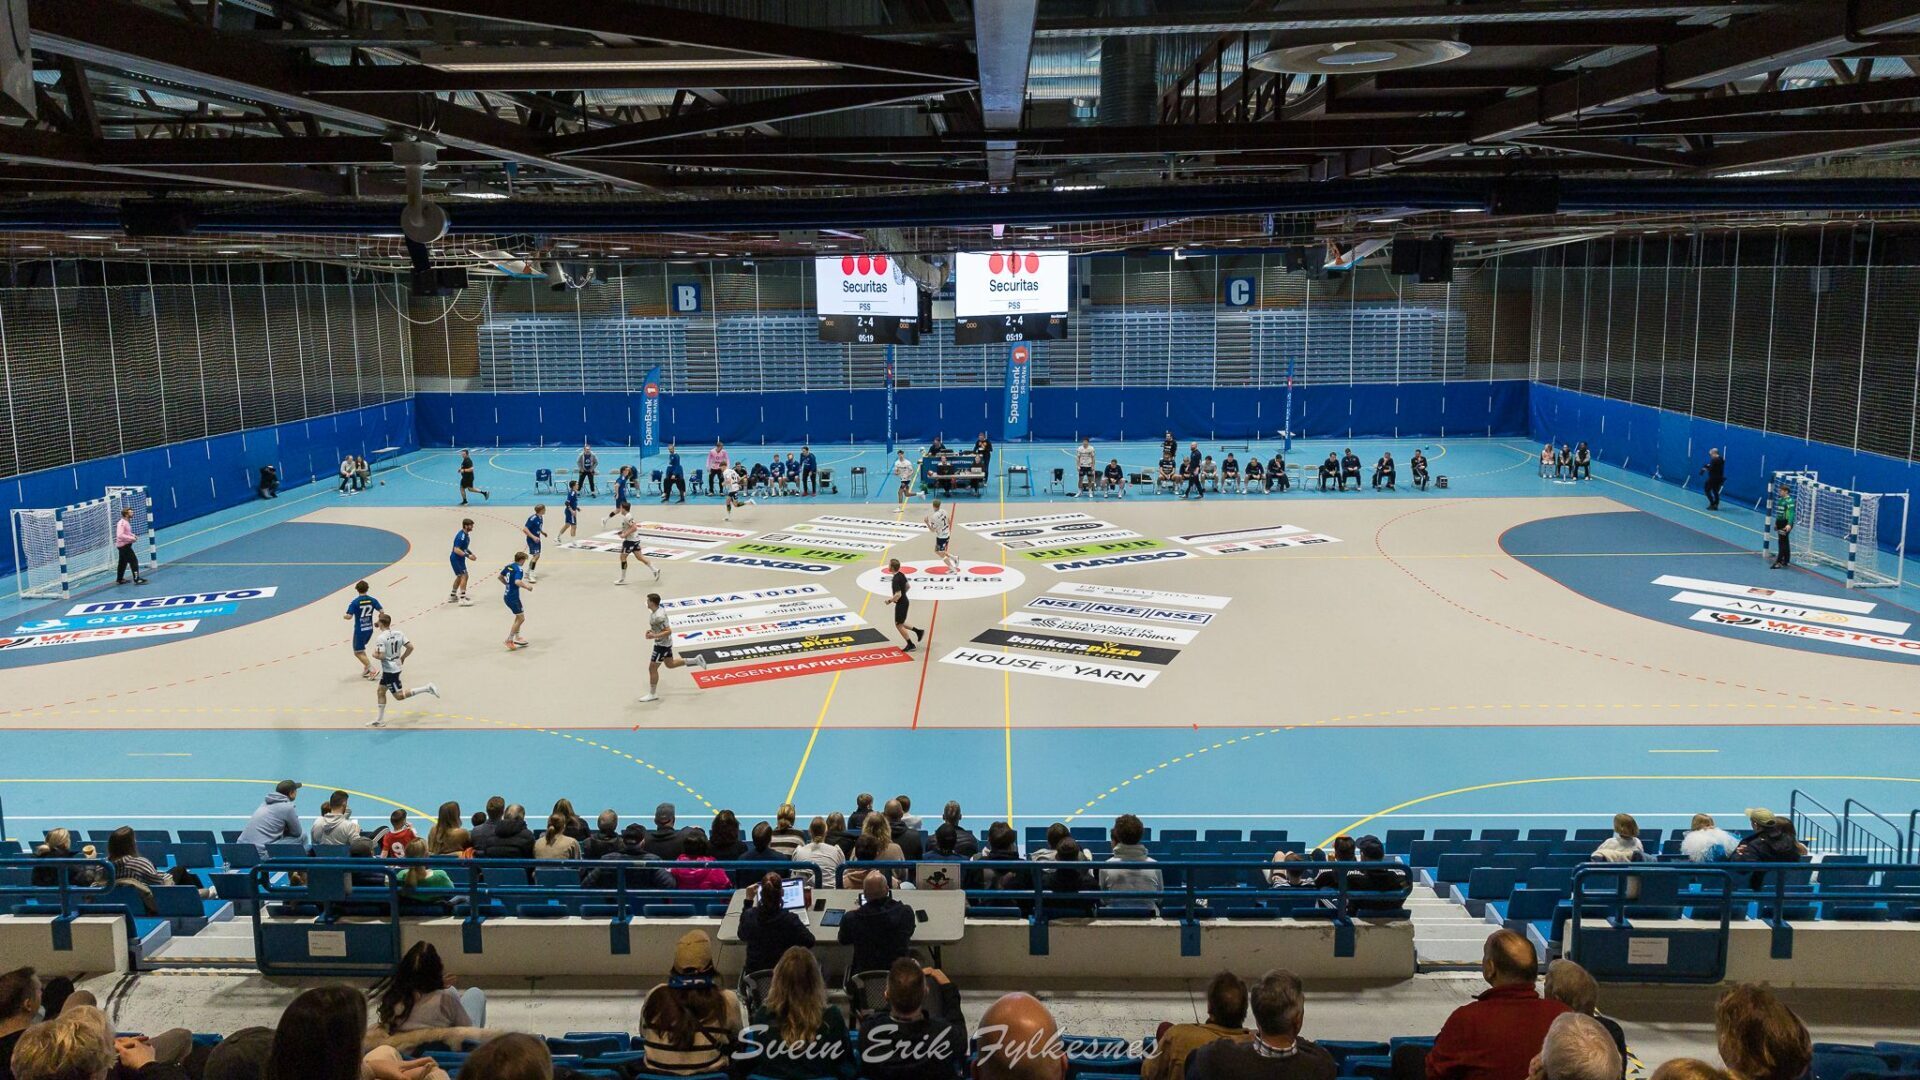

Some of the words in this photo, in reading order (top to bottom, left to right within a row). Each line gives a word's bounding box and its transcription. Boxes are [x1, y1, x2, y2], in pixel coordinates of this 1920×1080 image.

[843, 280, 888, 294] Securitas
[989, 279, 1039, 292] Securitas
[1230, 280, 1250, 305] C
[678, 286, 696, 311] B
[859, 302, 871, 311] PSS
[1008, 302, 1020, 310] PSS
[858, 334, 874, 342] 05:19
[1006, 333, 1022, 341] 05:19
[1008, 366, 1020, 424] SpareBank
[644, 398, 653, 446] SpareBank
[698, 556, 832, 572] MAXBO
[1053, 551, 1188, 570] MAXBO
[754, 587, 816, 598] 1000
[1037, 598, 1086, 608] NSE
[1095, 604, 1144, 614] NSE
[360, 606, 373, 618] 72
[1154, 610, 1204, 621] NSE
[41, 623, 184, 642] WESTCO
[706, 615, 846, 636] INTERSPORT
[1062, 620, 1154, 634] STAVANGER
[700, 650, 904, 683] SKAGENTRAFIKKSKOLE
[954, 652, 1048, 670] HOUSE
[1073, 666, 1146, 683] YARN
